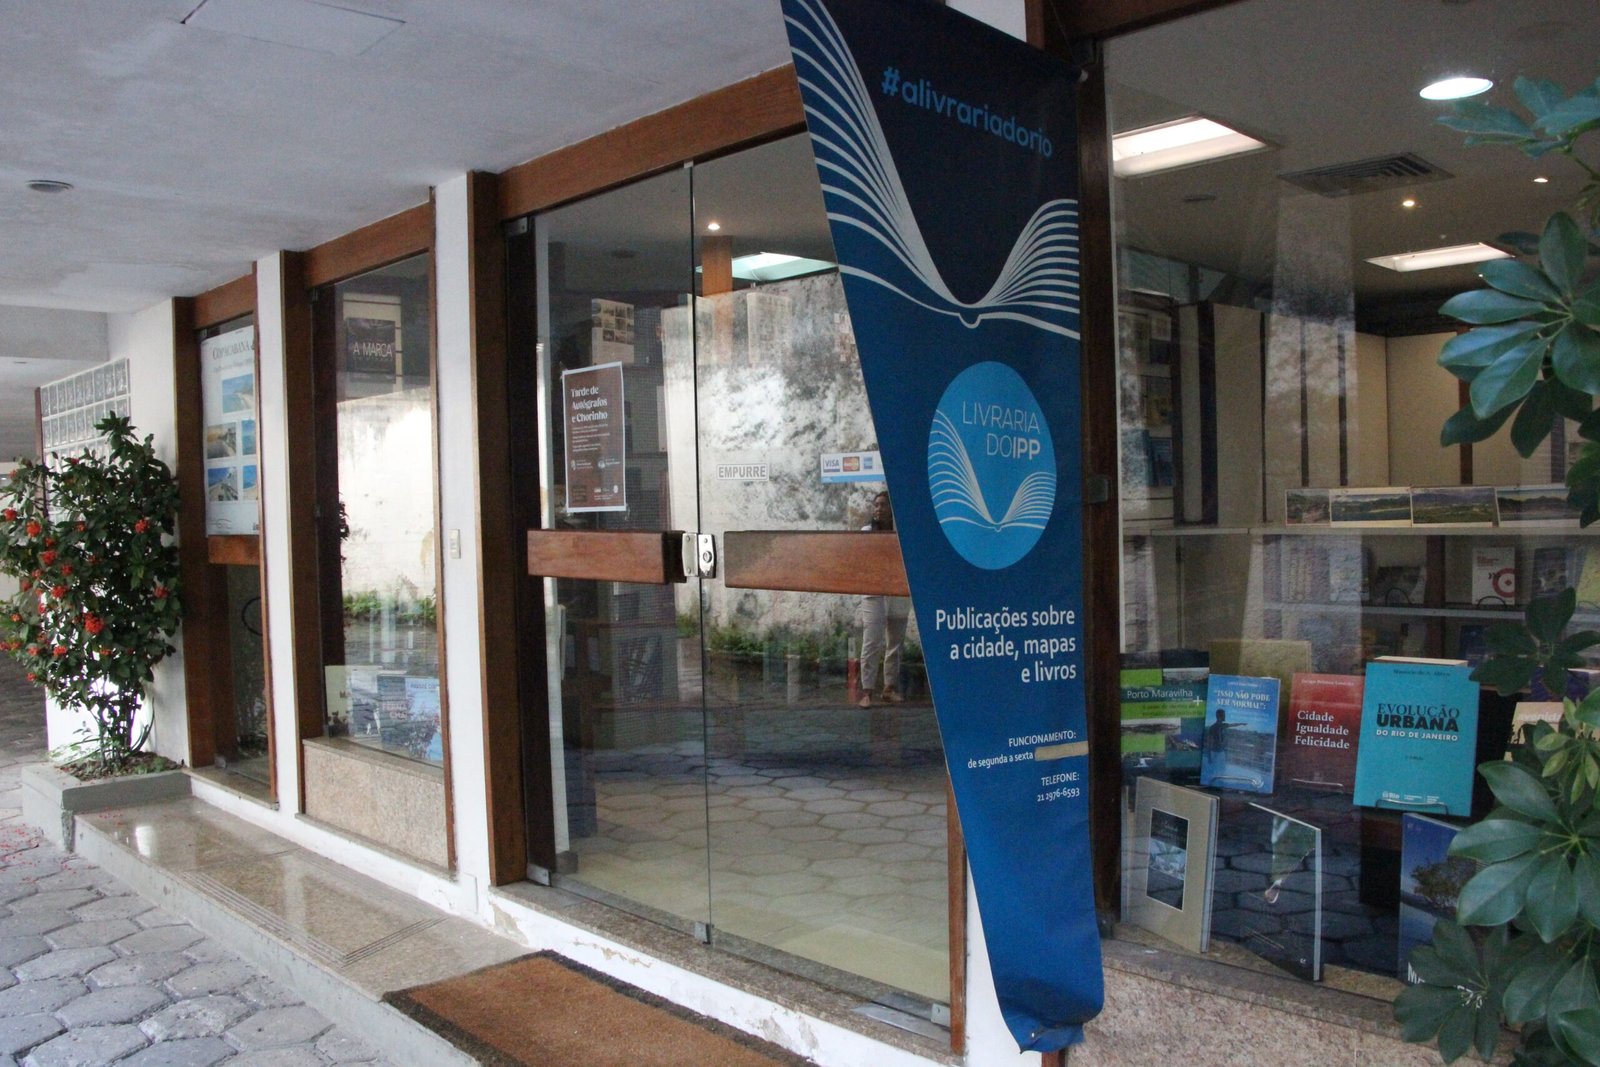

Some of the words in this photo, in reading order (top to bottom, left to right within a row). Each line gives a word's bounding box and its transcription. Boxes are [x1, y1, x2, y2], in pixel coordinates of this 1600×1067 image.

[881, 66, 1054, 158] #alivrariadorio
[362, 342, 393, 358] MARCA
[570, 387, 590, 399] Tarde
[590, 385, 599, 396] de
[576, 410, 608, 423] Chorinho
[962, 400, 1041, 434] LIVRARIA
[825, 459, 840, 468] VISA
[718, 465, 766, 478] EMPURRE
[935, 606, 1028, 634] Publicações
[1031, 604, 1076, 626] sobre
[950, 644, 960, 660] a
[963, 635, 1020, 661] cidade,
[1023, 636, 1076, 660] mapas
[1021, 667, 1031, 683] e
[1034, 661, 1077, 682] livros
[1126, 690, 1150, 699] Porto
[1151, 688, 1194, 698] Maravilha
[1251, 692, 1271, 702] PODE
[1296, 710, 1335, 722] Cidade
[1377, 702, 1460, 719] EVOLUÇÃO
[1295, 722, 1350, 736] Igualdade
[1376, 713, 1459, 732] URBANA
[1008, 730, 1077, 747] FUNCIONAMENTO:
[1294, 735, 1350, 750] Felicidade
[1421, 733, 1458, 742] JANEIRO
[967, 758, 977, 769] de
[978, 753, 1008, 768] segunda
[1009, 754, 1014, 763] a
[1014, 751, 1034, 762] sexta
[1041, 771, 1080, 787] TELEFONE:
[1037, 792, 1045, 802] 21
[1045, 787, 1080, 802] 2976-6593
